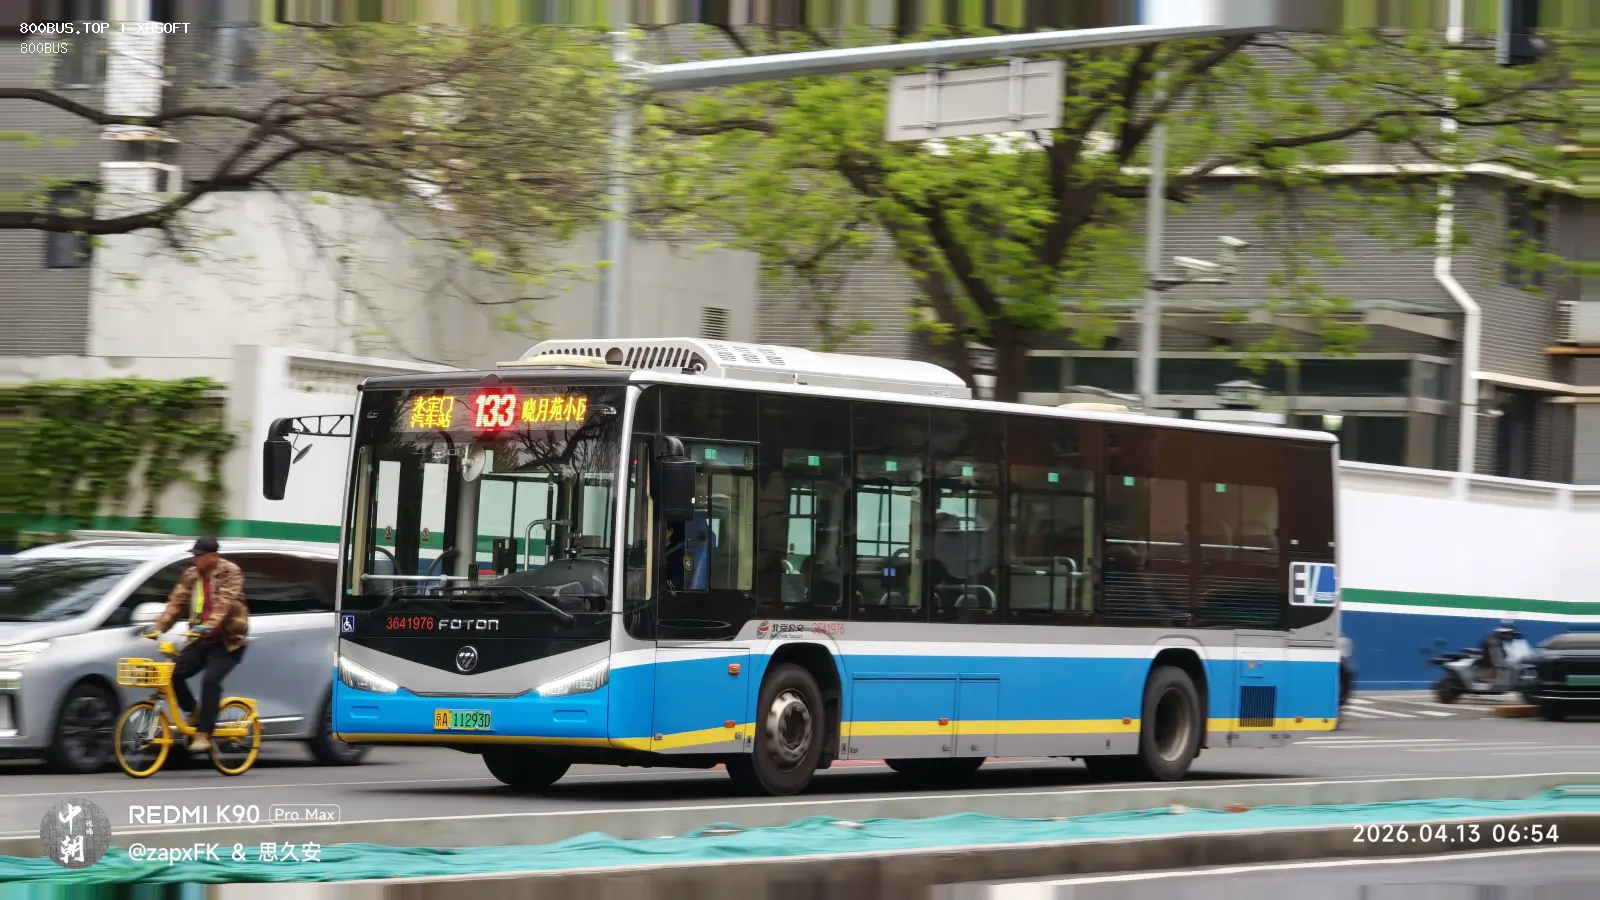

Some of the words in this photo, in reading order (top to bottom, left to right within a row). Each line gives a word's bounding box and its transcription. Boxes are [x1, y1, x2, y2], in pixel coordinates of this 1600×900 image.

[413, 396, 454, 412] 永定门
[475, 394, 516, 427] 133
[521, 397, 587, 422] 晓月苑小区
[410, 413, 452, 428] 汽车站
[386, 616, 434, 630] 3641976
[438, 619, 499, 630] FOTON
[771, 623, 804, 633] 北京公交
[813, 622, 844, 635] 3641976
[453, 713, 491, 727] 11293D
